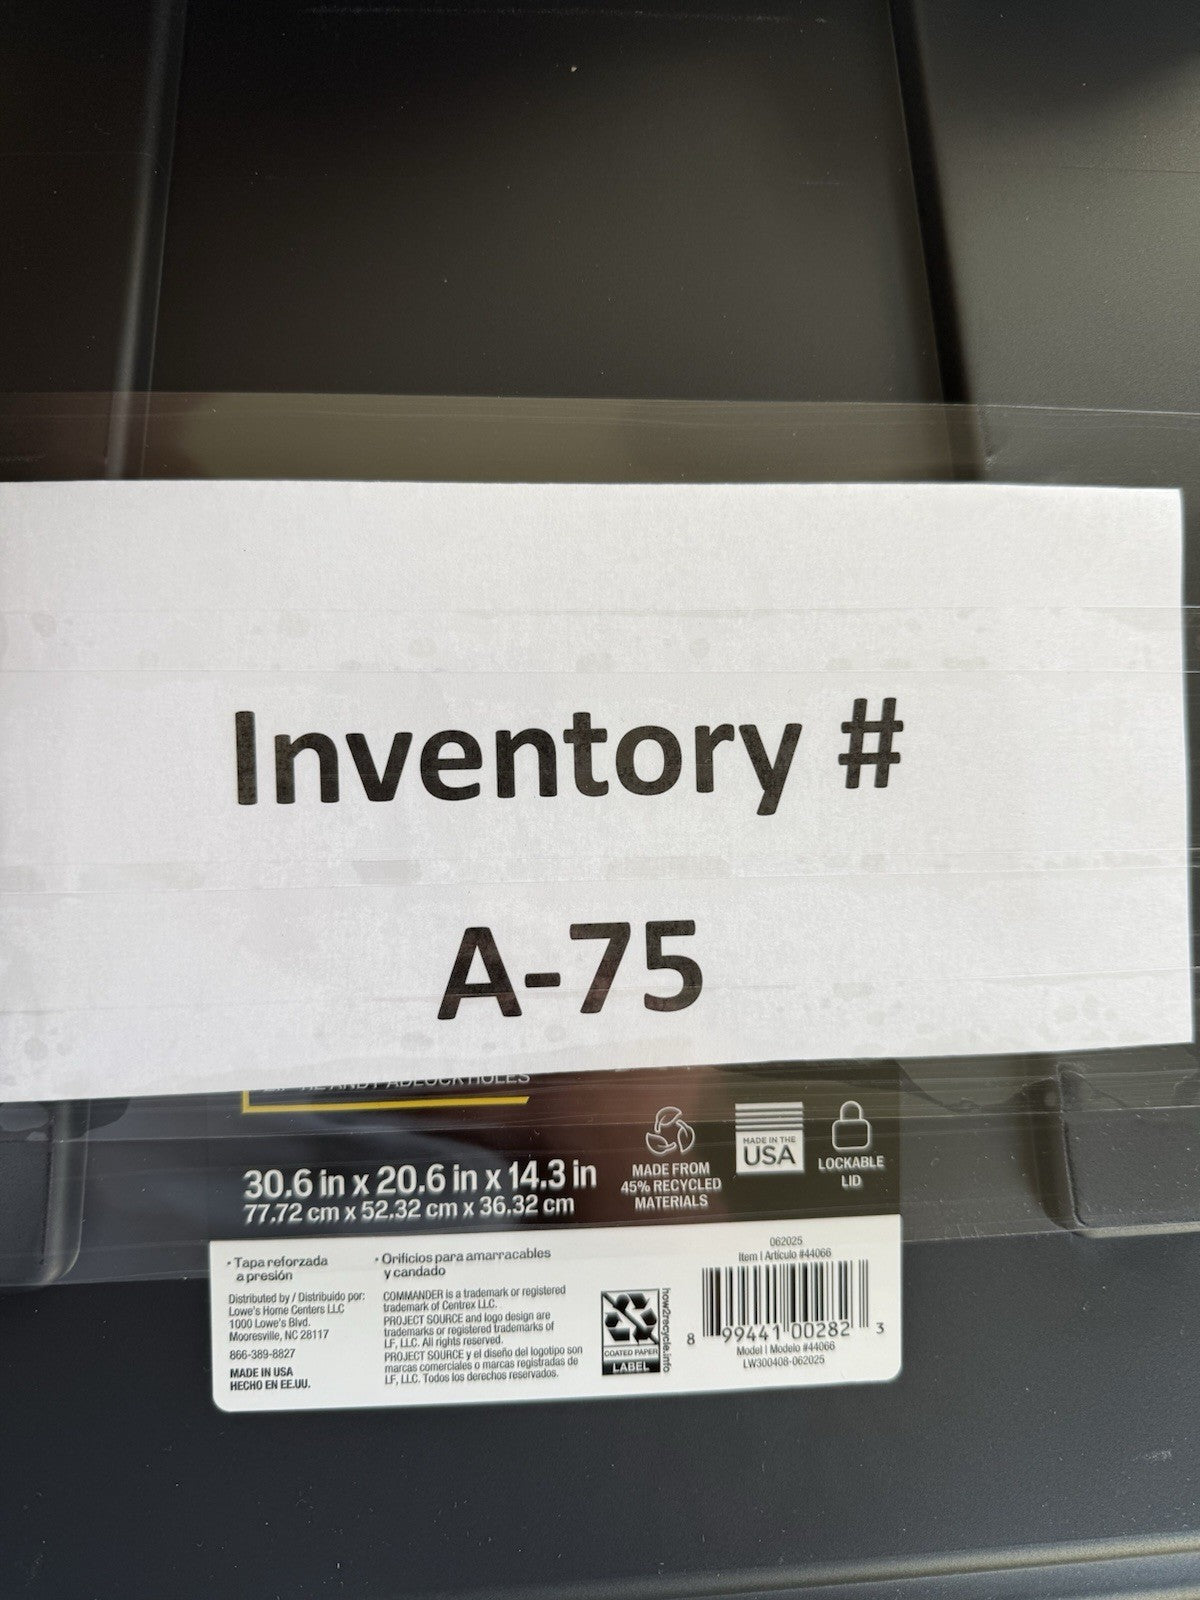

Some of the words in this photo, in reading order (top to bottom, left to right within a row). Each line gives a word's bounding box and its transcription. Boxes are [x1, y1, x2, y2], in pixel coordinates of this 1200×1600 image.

[234, 710, 803, 816] Inventory
[837, 696, 904, 789] #
[436, 919, 704, 1020] A-75
[743, 1136, 766, 1144] MADE
[744, 1145, 796, 1166] USA
[818, 1155, 884, 1170] LOCKABLE
[632, 1163, 669, 1177] MADE
[672, 1162, 710, 1175] FROM
[243, 1168, 313, 1198] 30.6
[319, 1169, 345, 1197] in
[353, 1174, 369, 1196] x
[376, 1164, 446, 1194] 20.6
[453, 1164, 478, 1192] in
[485, 1169, 501, 1190] x
[508, 1159, 566, 1190] 14.3
[573, 1159, 597, 1188] in
[621, 1181, 651, 1194] 45%
[654, 1178, 721, 1192] RECYCLED
[841, 1174, 862, 1188] LID
[244, 1203, 303, 1224] 77.72
[307, 1205, 340, 1222] cm
[345, 1206, 357, 1220] x
[361, 1199, 421, 1220] 52.32
[426, 1201, 457, 1218] cm
[463, 1201, 474, 1216] x
[479, 1194, 538, 1216] 36.32
[543, 1197, 575, 1215] cm
[635, 1194, 708, 1210] MATERIALS
[770, 1236, 803, 1247] 062025
[234, 1256, 264, 1269] Tapa
[267, 1255, 328, 1267] reforzada
[382, 1252, 432, 1264] Orificios
[435, 1253, 464, 1266] para
[466, 1248, 551, 1261] amarracables
[738, 1251, 758, 1262] Item
[765, 1249, 797, 1260] Artículo
[800, 1248, 832, 1258] #44066
[236, 1272, 244, 1281] a
[246, 1270, 293, 1282] presión
[384, 1269, 391, 1279] y
[394, 1266, 446, 1278] candado
[229, 1293, 277, 1304] Distributed
[279, 1293, 290, 1304] by
[298, 1291, 345, 1302] Distribuido
[347, 1292, 365, 1302] por:
[383, 1289, 443, 1300] COMMANDER
[446, 1288, 454, 1299] is
[456, 1290, 462, 1298] a
[463, 1287, 508, 1298] trademark
[510, 1288, 520, 1296] or
[522, 1285, 566, 1297] registered
[229, 1305, 261, 1316] Lowe's
[263, 1305, 289, 1316] Home
[291, 1304, 325, 1315] Centers
[327, 1303, 345, 1314] LLC
[383, 1302, 429, 1312] trademark
[431, 1301, 440, 1310] of
[442, 1300, 476, 1310] Centrex
[478, 1298, 498, 1308] LLC.
[229, 1319, 252, 1329] 1000
[254, 1318, 286, 1328] Lowe's
[288, 1317, 310, 1327] Blvd.
[384, 1315, 424, 1326] PROJECT
[426, 1314, 463, 1324] SOURCE
[466, 1314, 482, 1323] and
[484, 1313, 502, 1324] logo
[505, 1312, 534, 1323] design
[536, 1312, 550, 1320] are
[229, 1331, 282, 1342] Mooresville,
[284, 1330, 298, 1340] NC
[300, 1329, 330, 1340] 28117
[384, 1326, 434, 1337] trademarks
[436, 1327, 445, 1335] or
[448, 1324, 492, 1336] registered
[494, 1322, 543, 1333] trademarks
[546, 1321, 554, 1331] of
[661, 1287, 672, 1374] how2recycle.info
[686, 1332, 696, 1345] 8
[722, 1325, 780, 1343] 99441
[792, 1321, 850, 1340] 00282
[876, 1322, 885, 1334] 3
[384, 1339, 398, 1350] LF,
[400, 1338, 420, 1348] LLC.
[422, 1337, 434, 1346] All
[436, 1336, 461, 1348] rights
[463, 1335, 504, 1345] reserved.
[736, 1345, 762, 1356] Model
[770, 1343, 800, 1354] Modelo
[803, 1341, 836, 1352] #44066
[229, 1348, 296, 1360] 866-389-8827
[384, 1351, 424, 1362] PROJECT
[427, 1350, 464, 1360] SOURCE
[466, 1351, 471, 1360] y
[474, 1348, 482, 1358] el
[484, 1348, 512, 1358] diseño
[514, 1346, 528, 1357] del
[530, 1346, 564, 1358] logotipo
[566, 1346, 583, 1354] son
[604, 1349, 633, 1358] COATED
[634, 1348, 658, 1356] PAPER
[230, 1368, 258, 1378] MADE
[261, 1368, 272, 1377] IN
[274, 1367, 294, 1377] USA
[384, 1364, 418, 1374] marcas
[420, 1362, 472, 1372] comerciales
[474, 1362, 480, 1370] o
[482, 1360, 514, 1370] marcas
[517, 1358, 565, 1370] registradas
[568, 1357, 578, 1366] de
[612, 1361, 650, 1373] LABEL
[385, 1375, 398, 1386] LF,
[400, 1374, 420, 1384] LLC.
[423, 1372, 450, 1383] Todos
[452, 1371, 464, 1382] los
[467, 1370, 506, 1381] derechos
[508, 1368, 559, 1380] reservados.
[230, 1381, 262, 1391] HECHO
[265, 1380, 278, 1390] EN
[280, 1379, 311, 1389] EE.UU.
